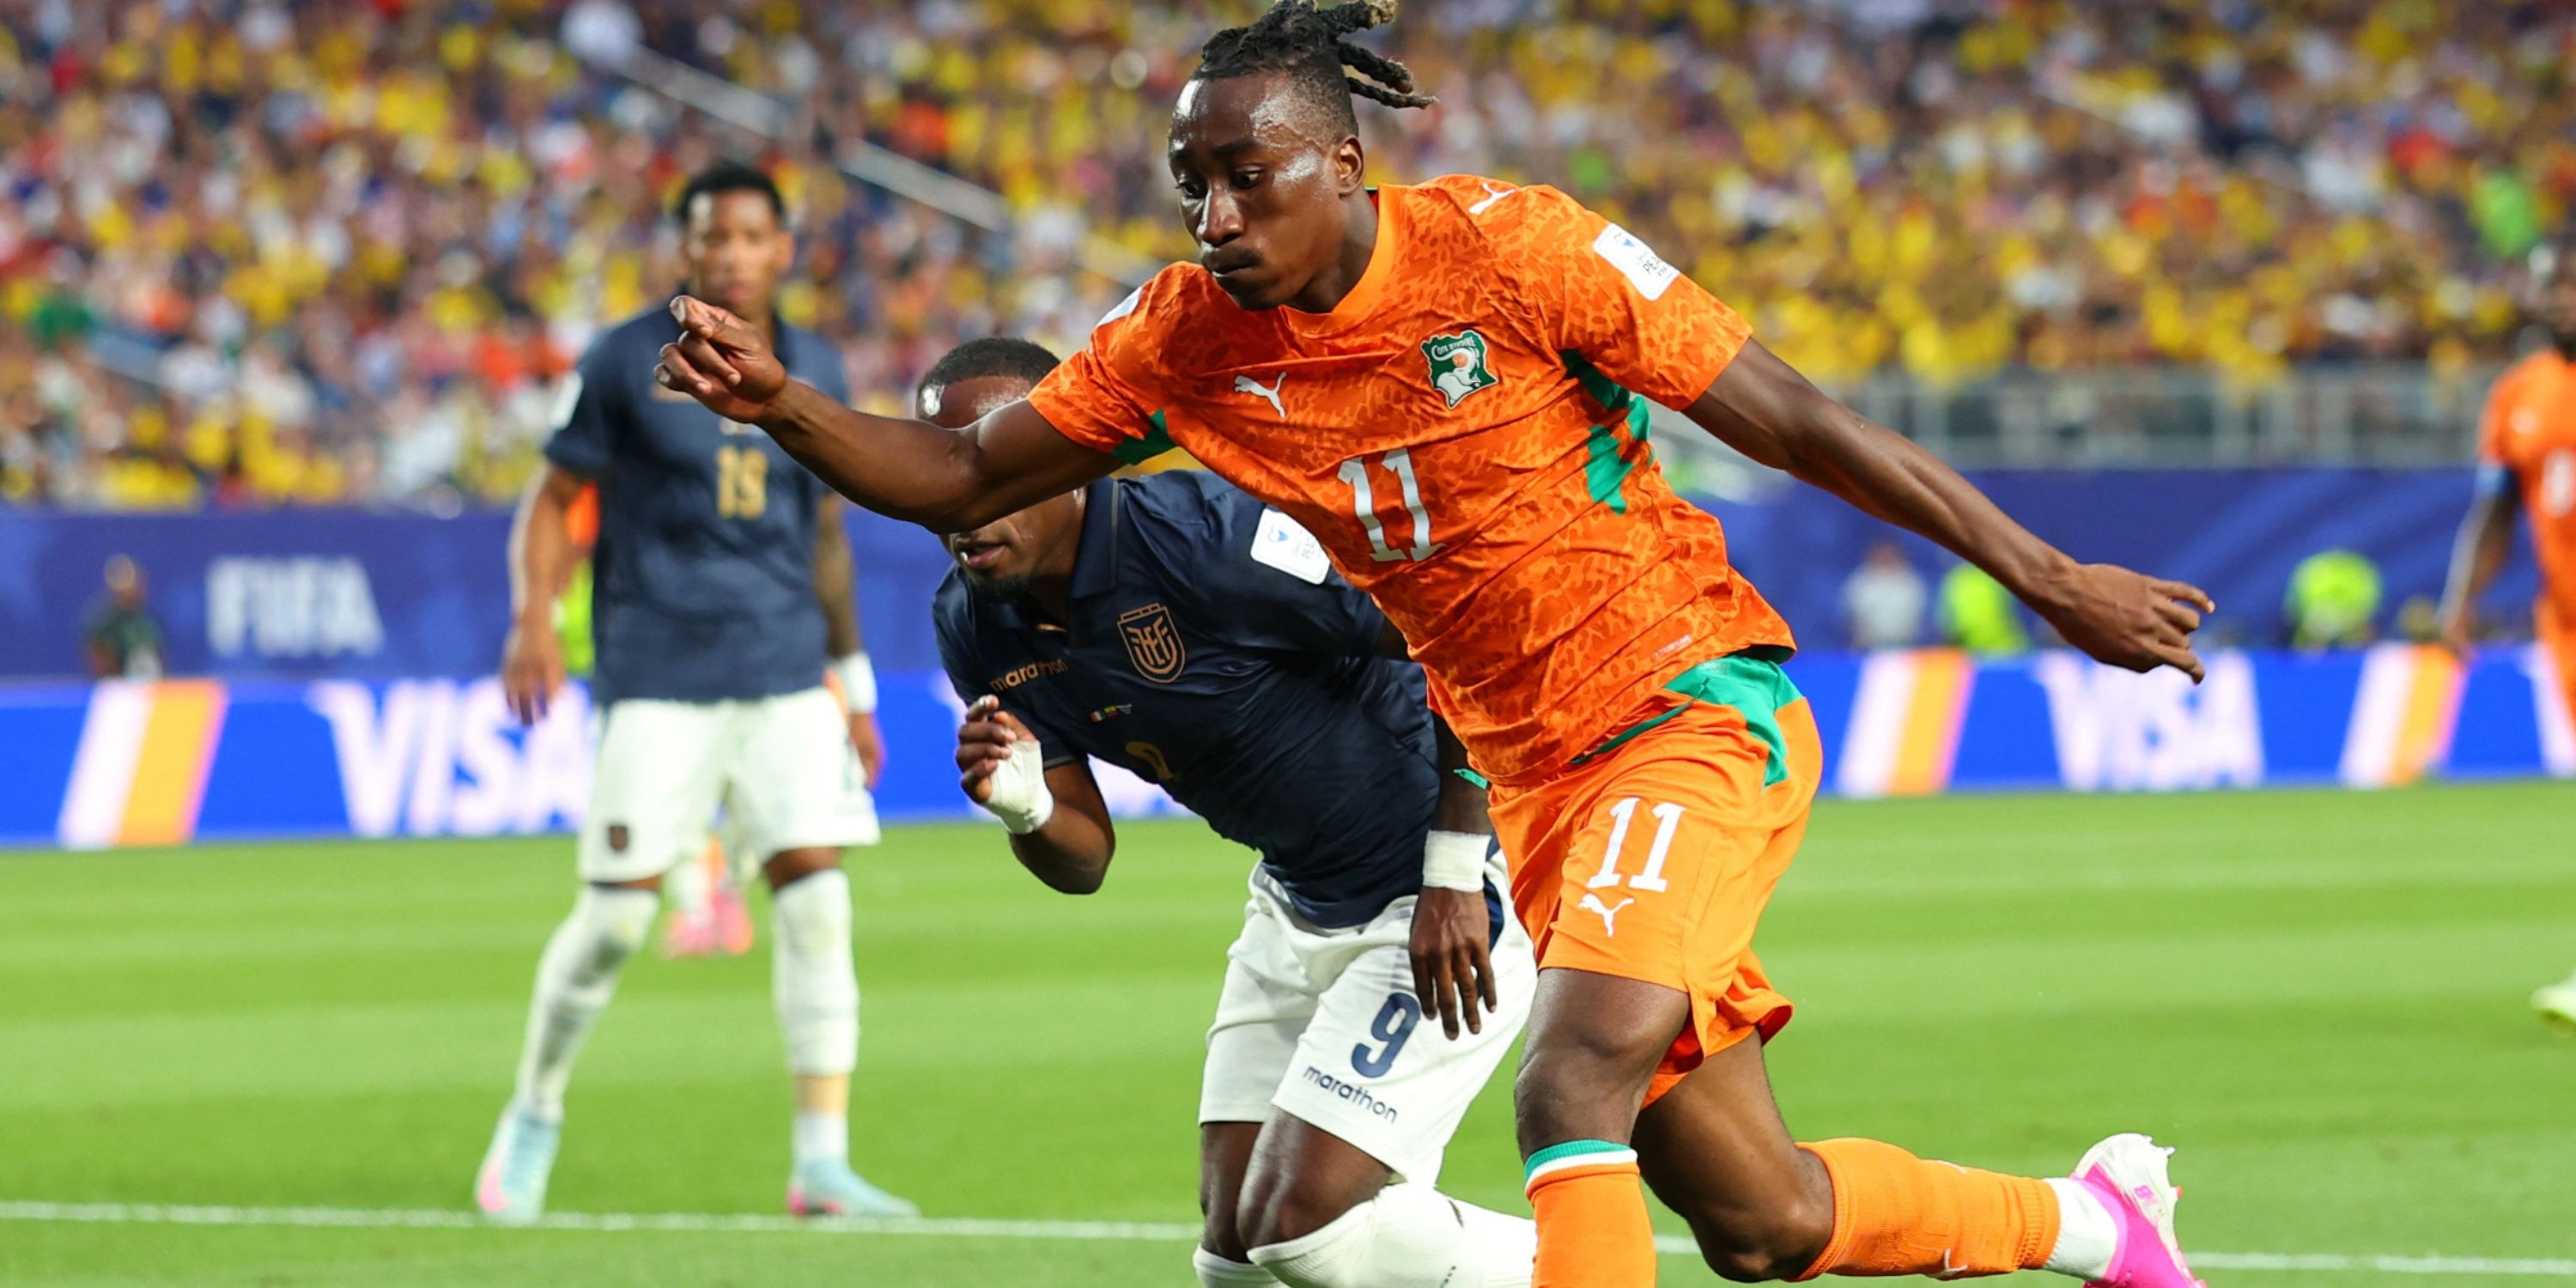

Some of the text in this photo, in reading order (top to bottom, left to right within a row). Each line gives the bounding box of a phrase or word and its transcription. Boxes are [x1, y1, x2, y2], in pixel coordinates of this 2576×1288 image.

[1337, 448, 1447, 562] 11
[206, 558, 383, 656] FIFA
[309, 678, 596, 835] VISA
[2035, 650, 2264, 792] VISA
[1586, 797, 1688, 893] 11
[1351, 992, 1421, 1078] 9
[1303, 1066, 1399, 1123] marathon
